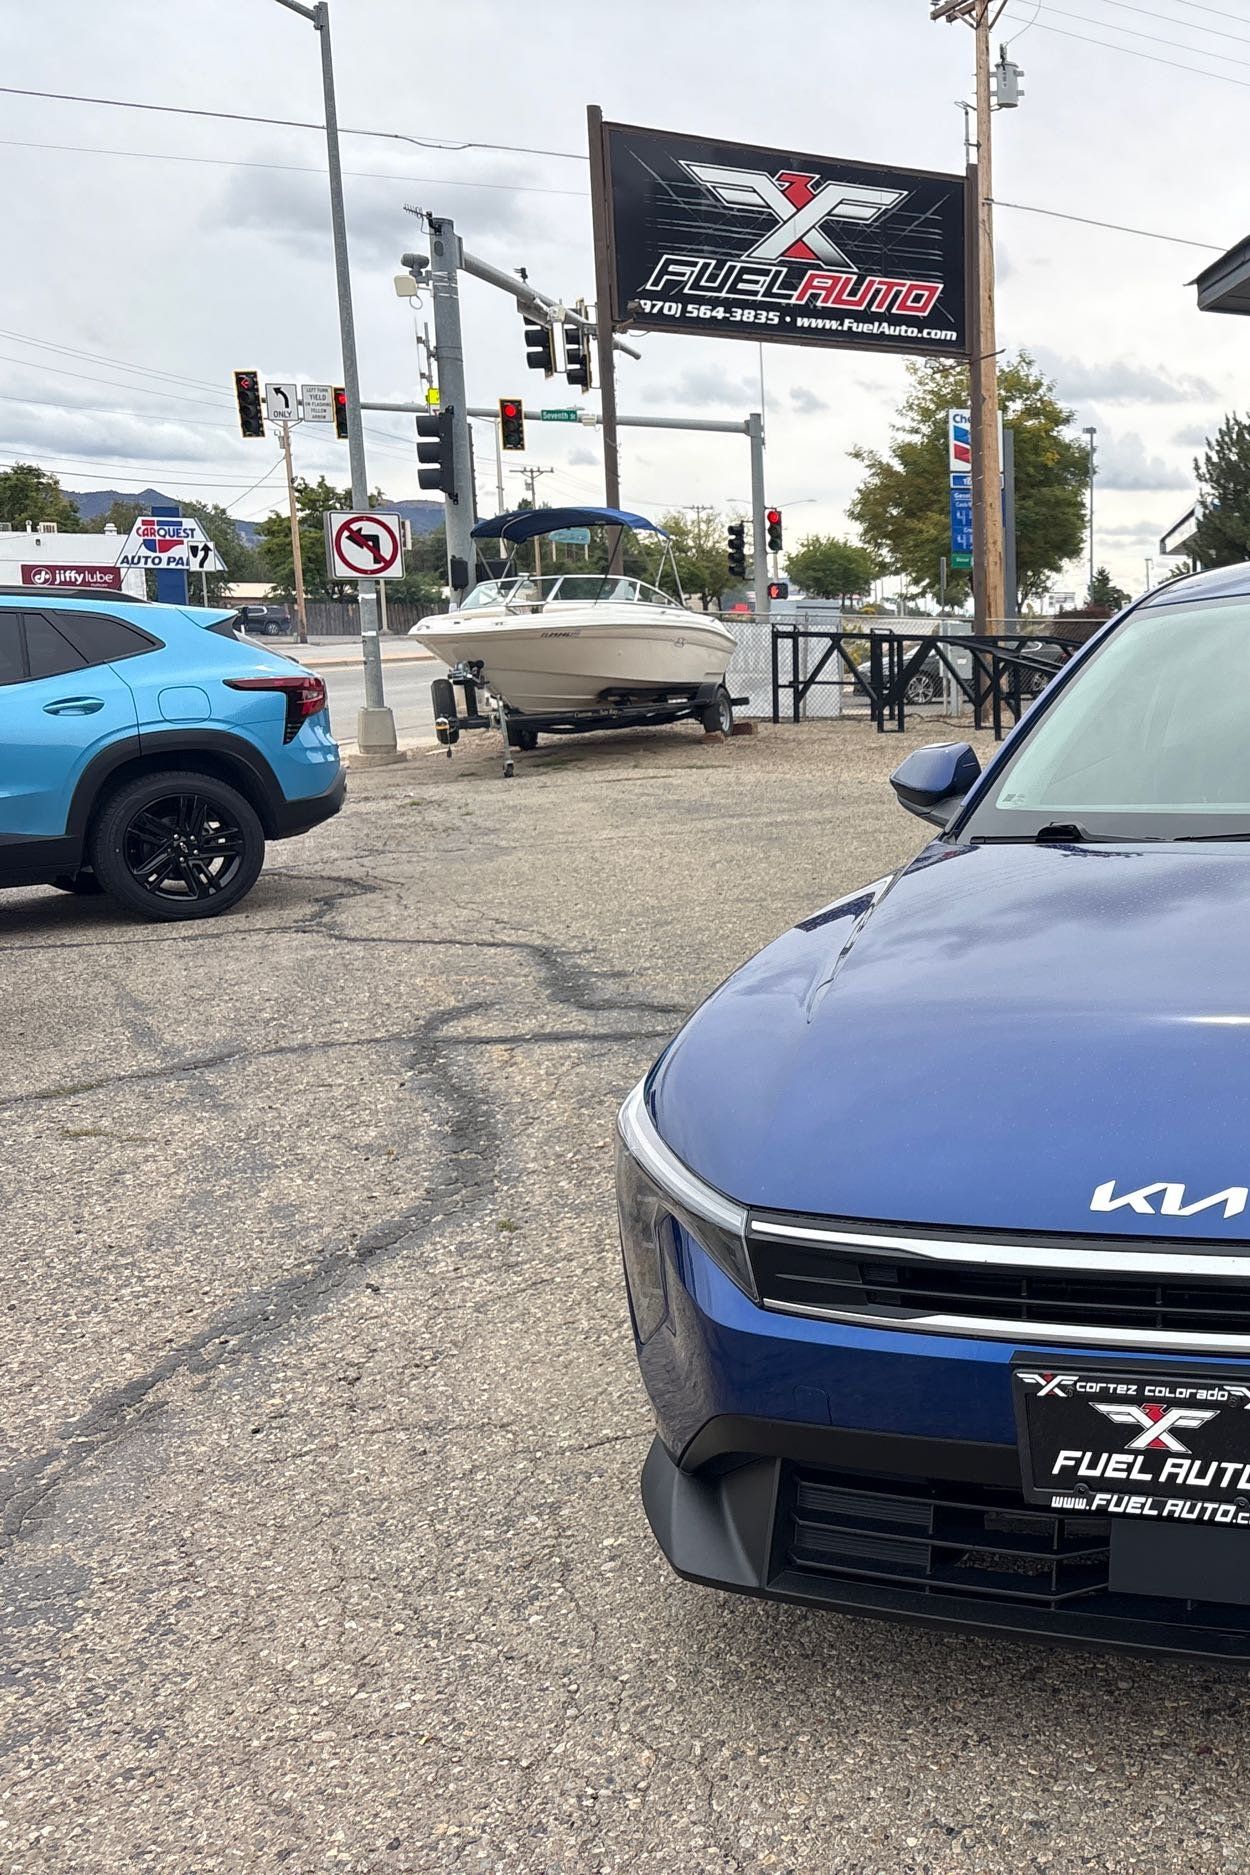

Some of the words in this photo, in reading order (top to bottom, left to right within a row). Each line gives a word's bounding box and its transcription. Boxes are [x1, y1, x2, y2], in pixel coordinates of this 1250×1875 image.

[645, 254, 799, 304] FUEL
[791, 270, 944, 317] AUTO
[634, 299, 682, 318] 970)
[685, 304, 780, 324] 564-3835
[796, 316, 957, 341] www.FuelAuto.com
[273, 410, 292, 418] ONLY
[136, 526, 196, 539] CARQUEST
[120, 555, 163, 566] AUTO
[55, 570, 84, 585] jiffy
[85, 570, 114, 583] lube
[1090, 1180, 1249, 1219] KIA
[1052, 1450, 1153, 1481] FUEL
